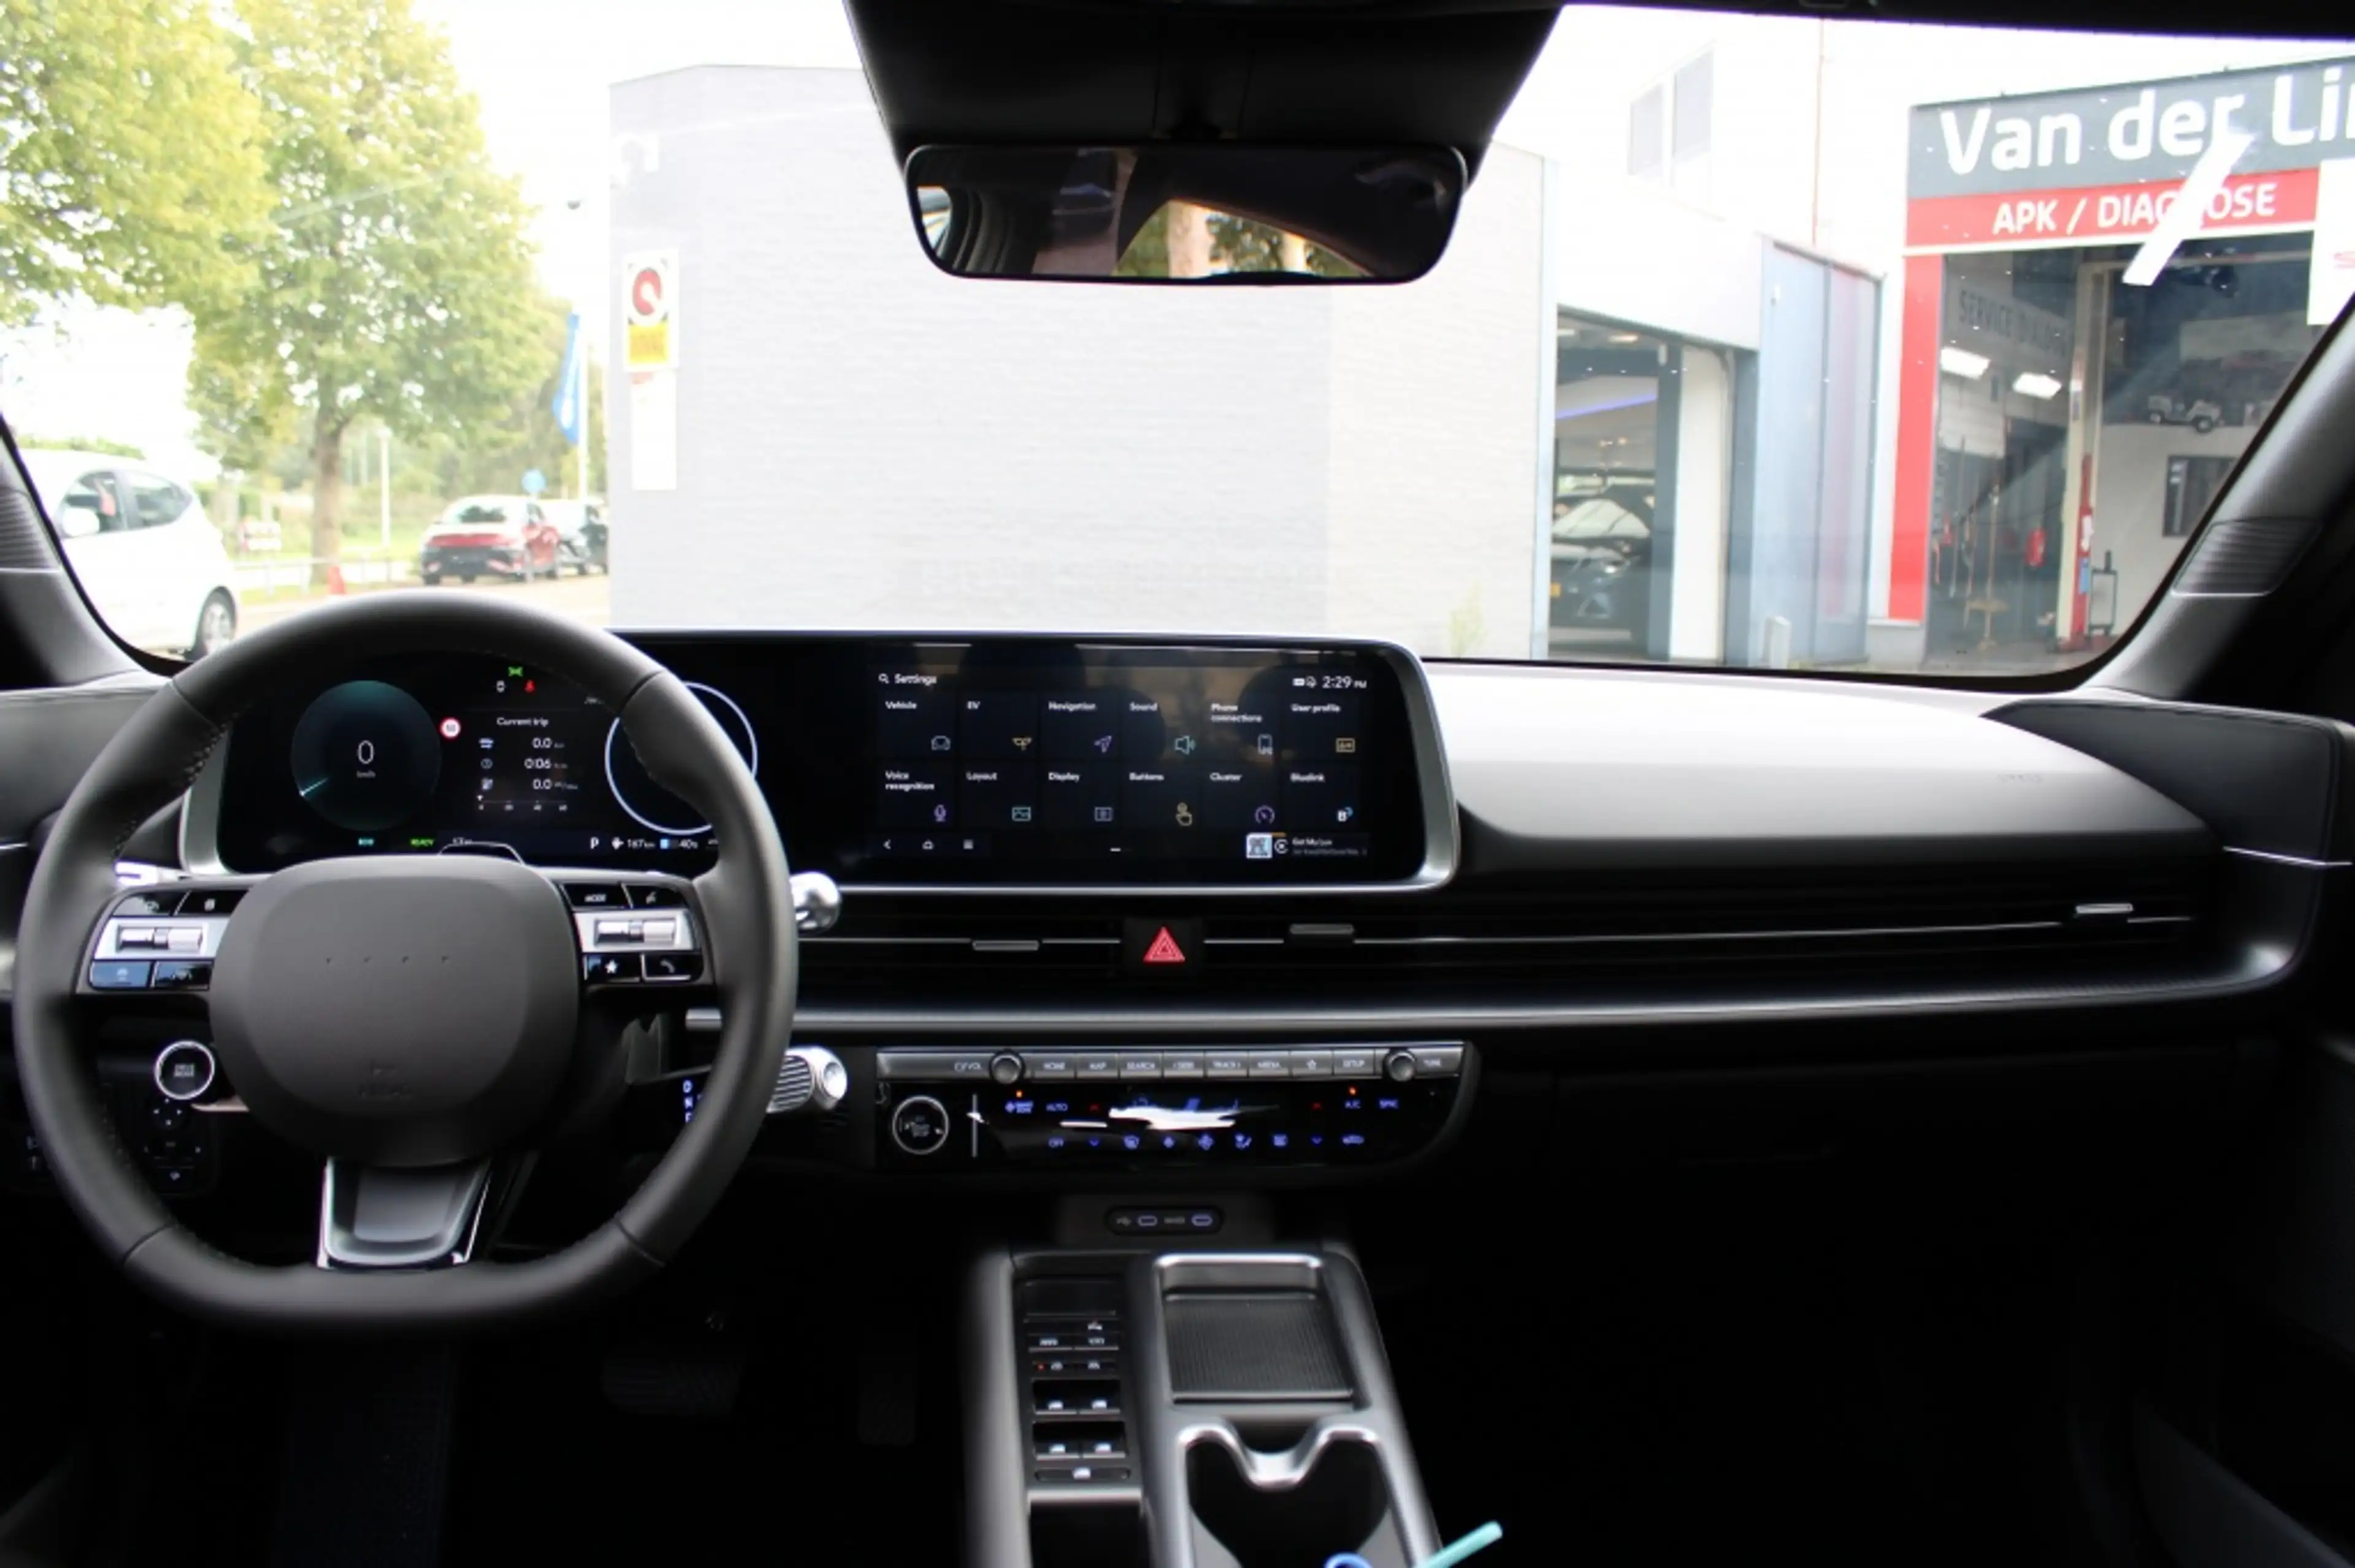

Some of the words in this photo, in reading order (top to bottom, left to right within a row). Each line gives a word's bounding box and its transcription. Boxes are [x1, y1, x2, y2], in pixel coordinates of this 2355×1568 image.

[1939, 104, 2081, 175] Van
[2107, 89, 2244, 160] der
[2272, 66, 2355, 146] Li
[1993, 201, 2057, 235] APK
[2066, 199, 2086, 234] /
[2097, 183, 2276, 228] DIAGOSE
[894, 673, 937, 686] Settings
[1322, 676, 1352, 689] 2:29
[1354, 680, 1367, 689] PM
[886, 701, 917, 709] Vehicle
[967, 701, 980, 709] EV
[1048, 701, 1097, 711] Navigation
[1129, 702, 1157, 712] Sound
[1211, 703, 1238, 713] Phone
[1292, 703, 1311, 712] User
[1312, 703, 1341, 713] profile
[534, 717, 549, 727] trip
[1211, 714, 1262, 723] connections
[532, 737, 552, 749] 0.0
[358, 740, 374, 764] 0
[524, 758, 551, 769] 0:06
[885, 771, 909, 781] Voice
[966, 771, 997, 782] Layout
[1048, 771, 1080, 782] Display
[1129, 772, 1164, 781] Buttons
[1210, 772, 1243, 781] Cluster
[1290, 773, 1325, 782] Bluelink
[532, 779, 552, 789] 0.0
[885, 782, 934, 791] recognition
[590, 837, 599, 849] P
[1379, 1099, 1399, 1109] SYNC
[1049, 1139, 1064, 1148] OFF
